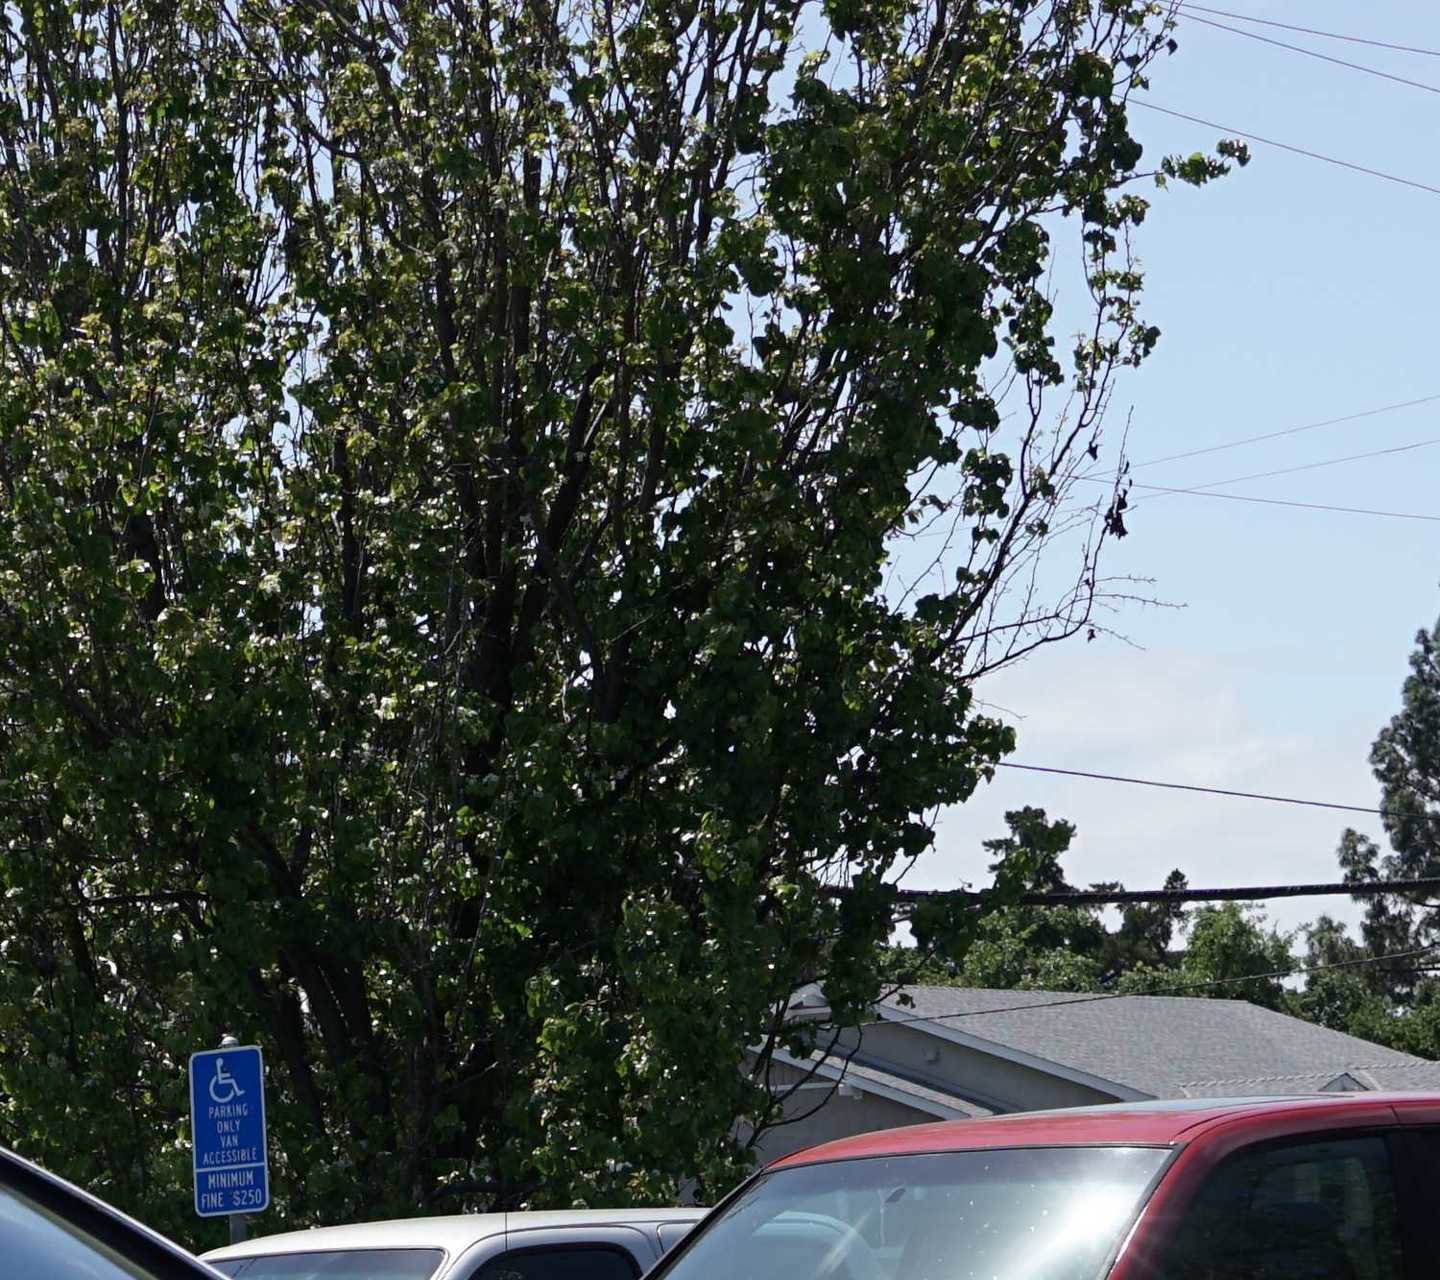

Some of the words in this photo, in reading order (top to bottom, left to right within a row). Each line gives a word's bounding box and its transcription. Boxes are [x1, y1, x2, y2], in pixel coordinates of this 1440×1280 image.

[208, 1103, 248, 1119] PARKING
[216, 1120, 240, 1134] ONLY
[220, 1135, 238, 1148] VAN
[203, 1149, 257, 1165] ACCESSIBLE
[208, 1170, 254, 1189] MINIMUM
[201, 1192, 224, 1209] FINE
[232, 1189, 262, 1206] $250
